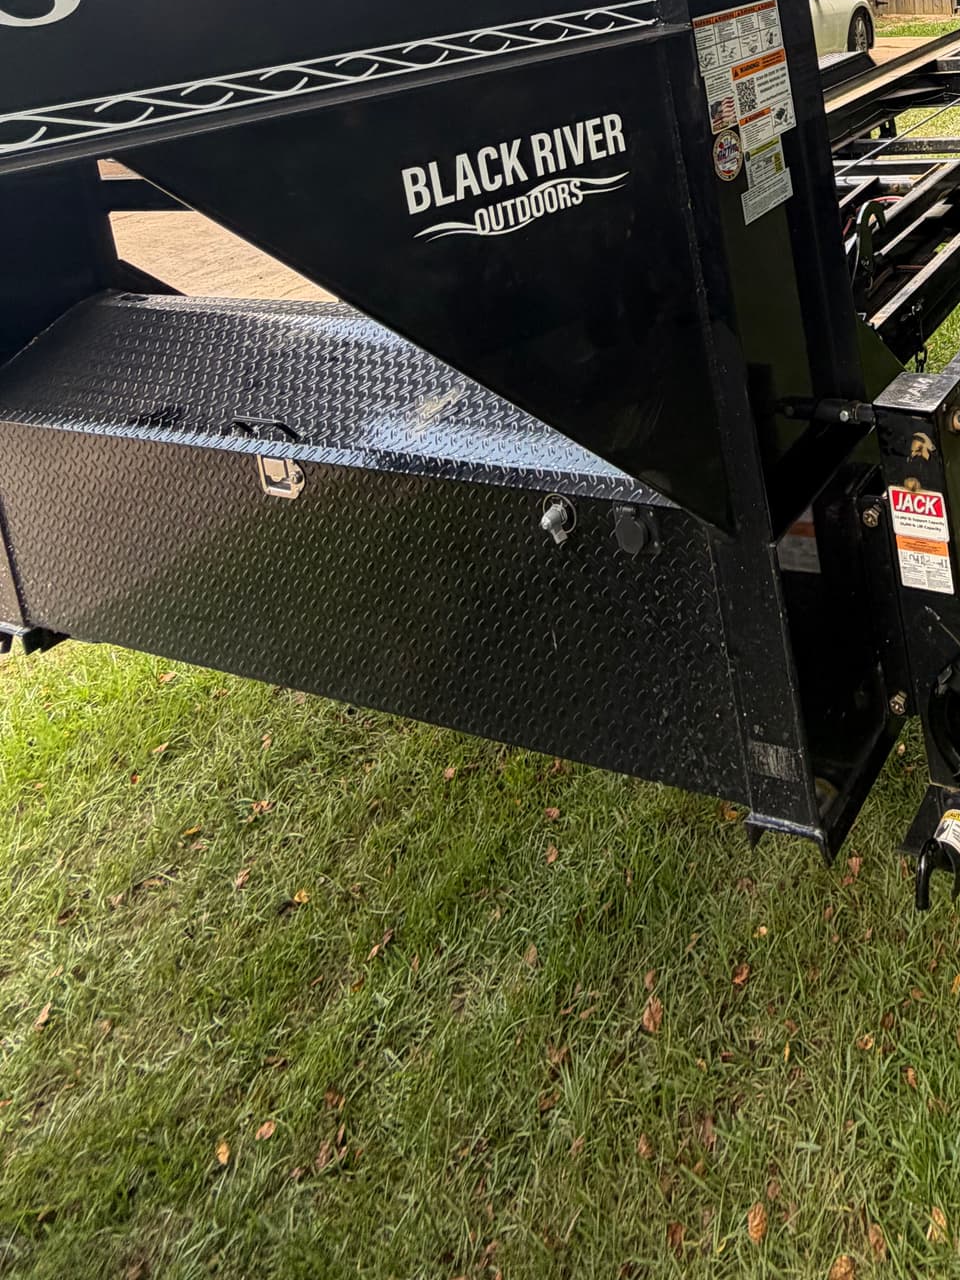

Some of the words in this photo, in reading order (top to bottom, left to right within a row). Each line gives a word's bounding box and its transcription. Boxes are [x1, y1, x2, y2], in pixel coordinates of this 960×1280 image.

[401, 138, 529, 216] BLACK
[530, 113, 627, 177] RIVER
[474, 180, 584, 235] OUTDOORS
[896, 493, 938, 515] JACK
